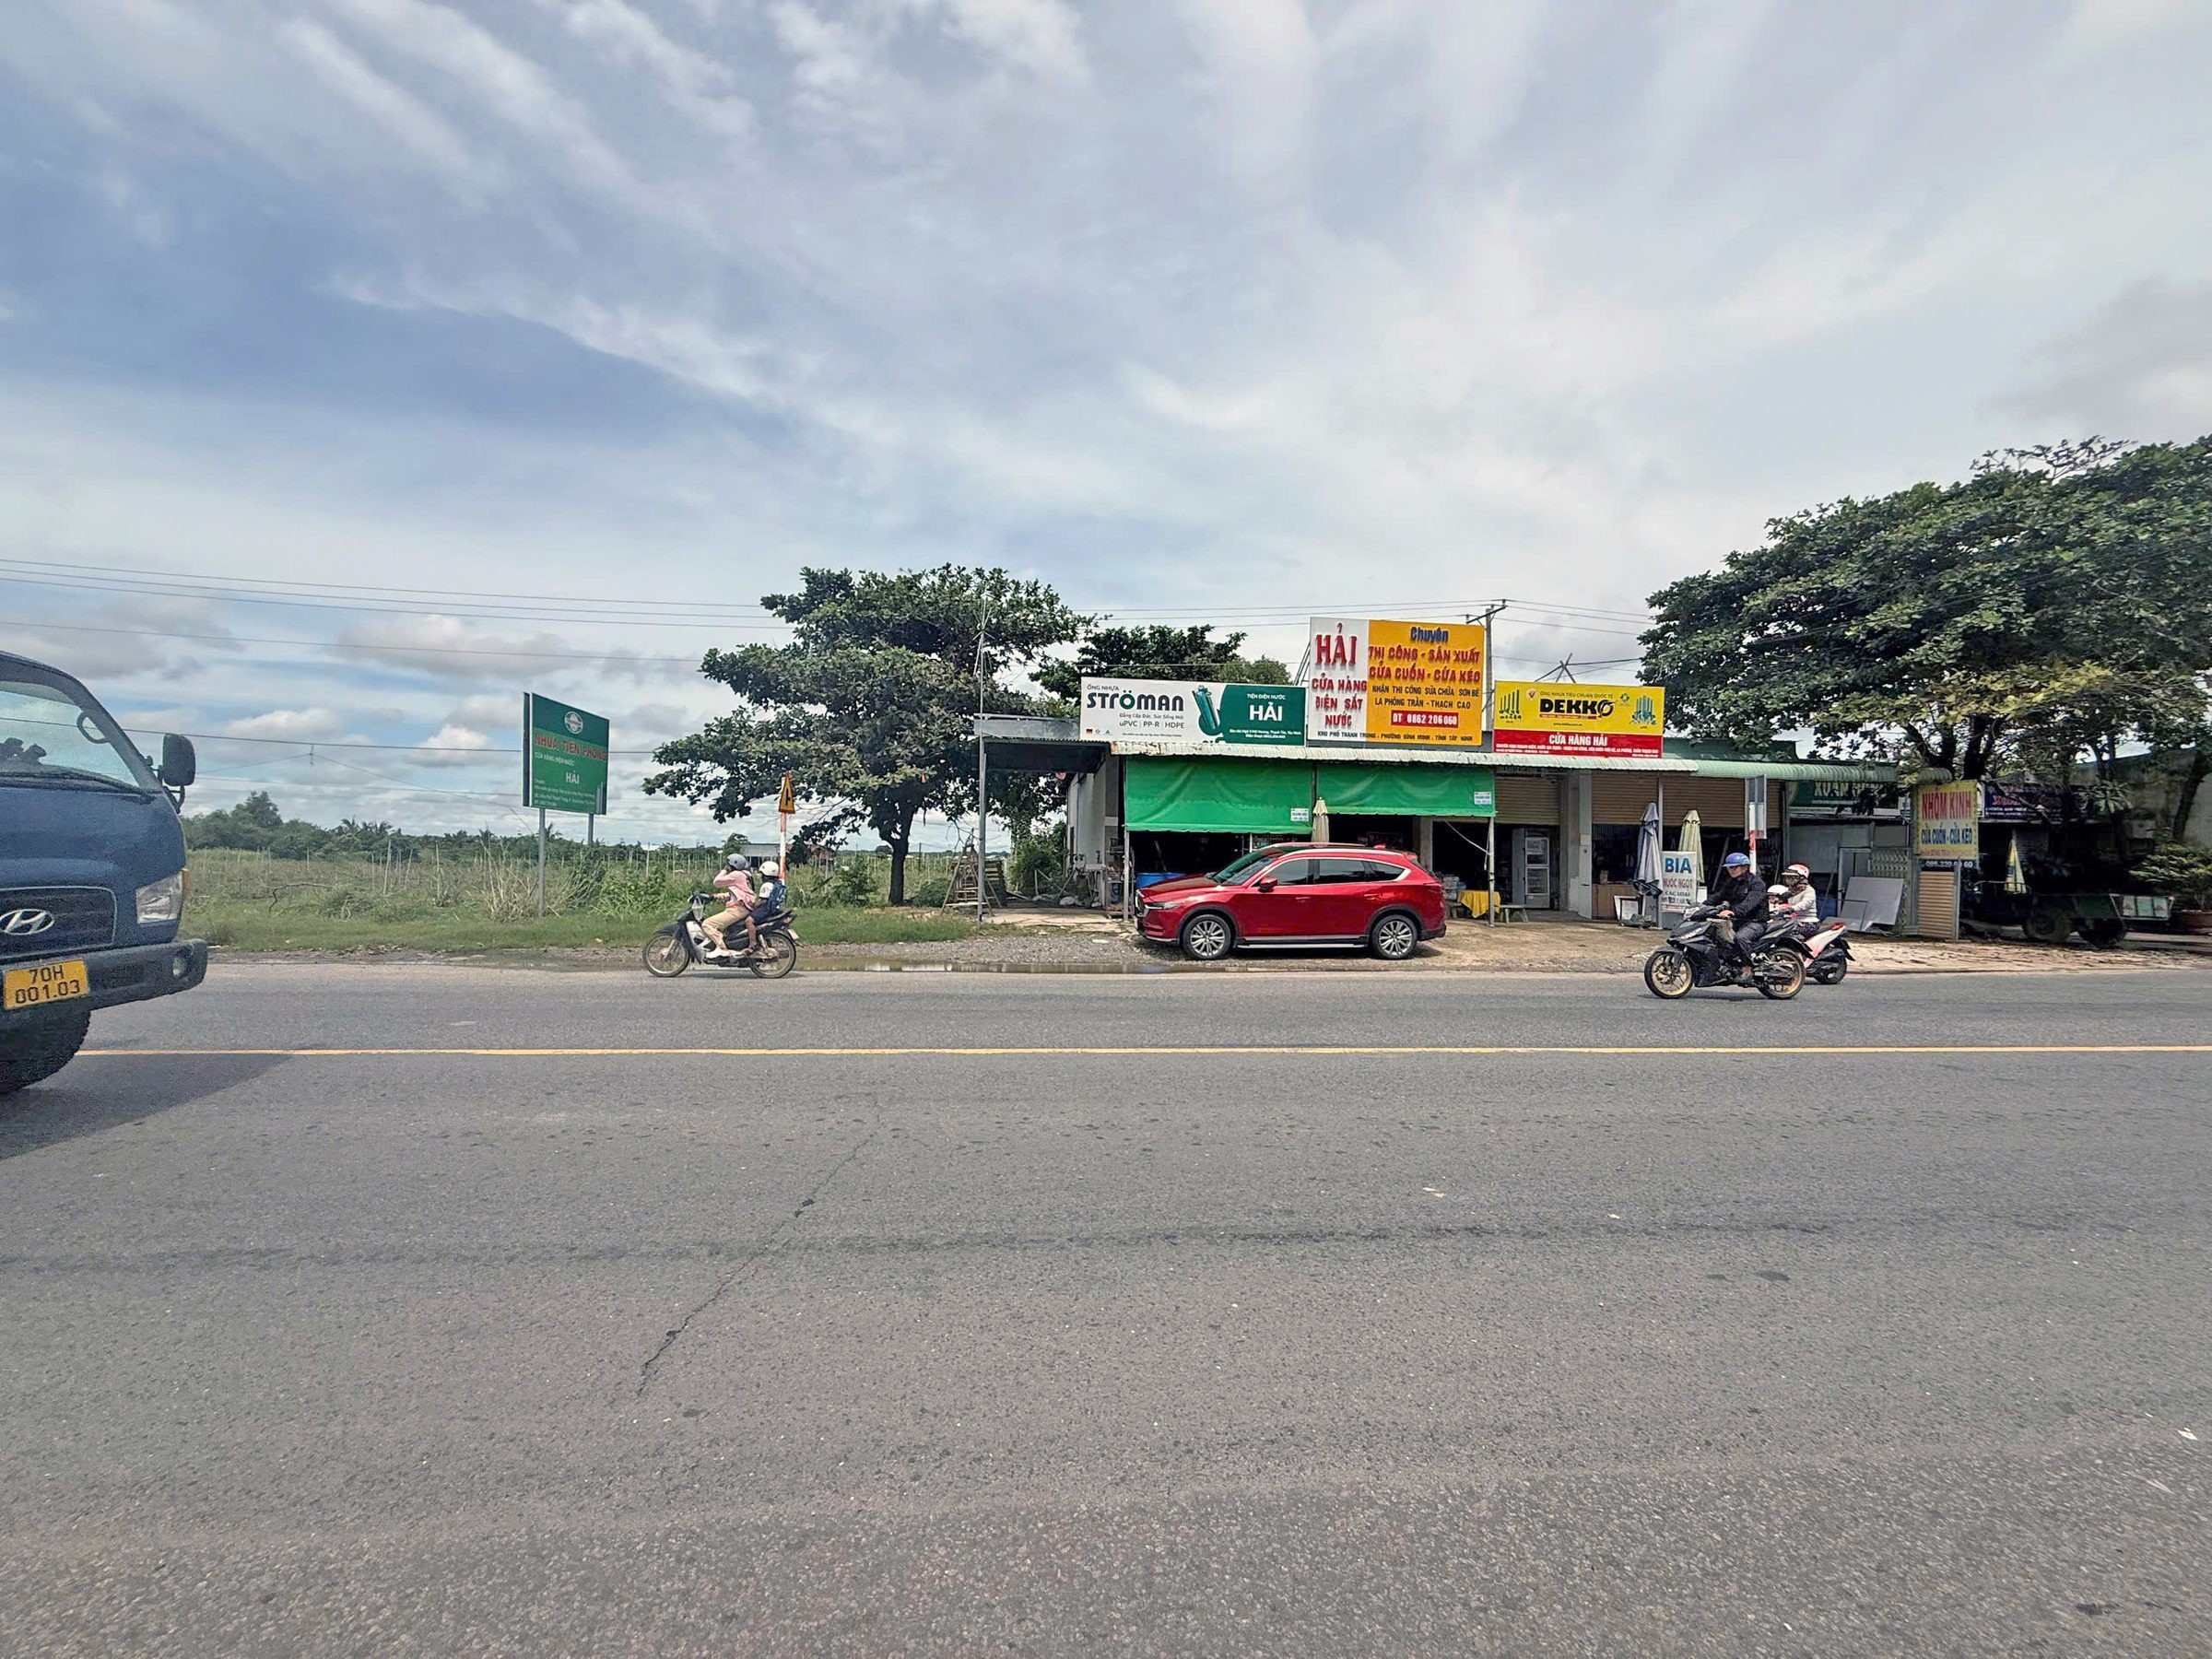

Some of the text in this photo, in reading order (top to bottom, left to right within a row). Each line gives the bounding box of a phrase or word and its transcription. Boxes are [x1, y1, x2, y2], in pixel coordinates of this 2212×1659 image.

[1315, 622, 1358, 665] HẢI
[1410, 627, 1449, 643] Chuyên
[1249, 701, 1283, 722] HẢI
[1539, 698, 1616, 718] DEKKO
[1568, 734, 1592, 746] HÀNG
[1665, 857, 1692, 874] BIA
[29, 965, 65, 983] 70H
[15, 980, 80, 1005] 001.03
